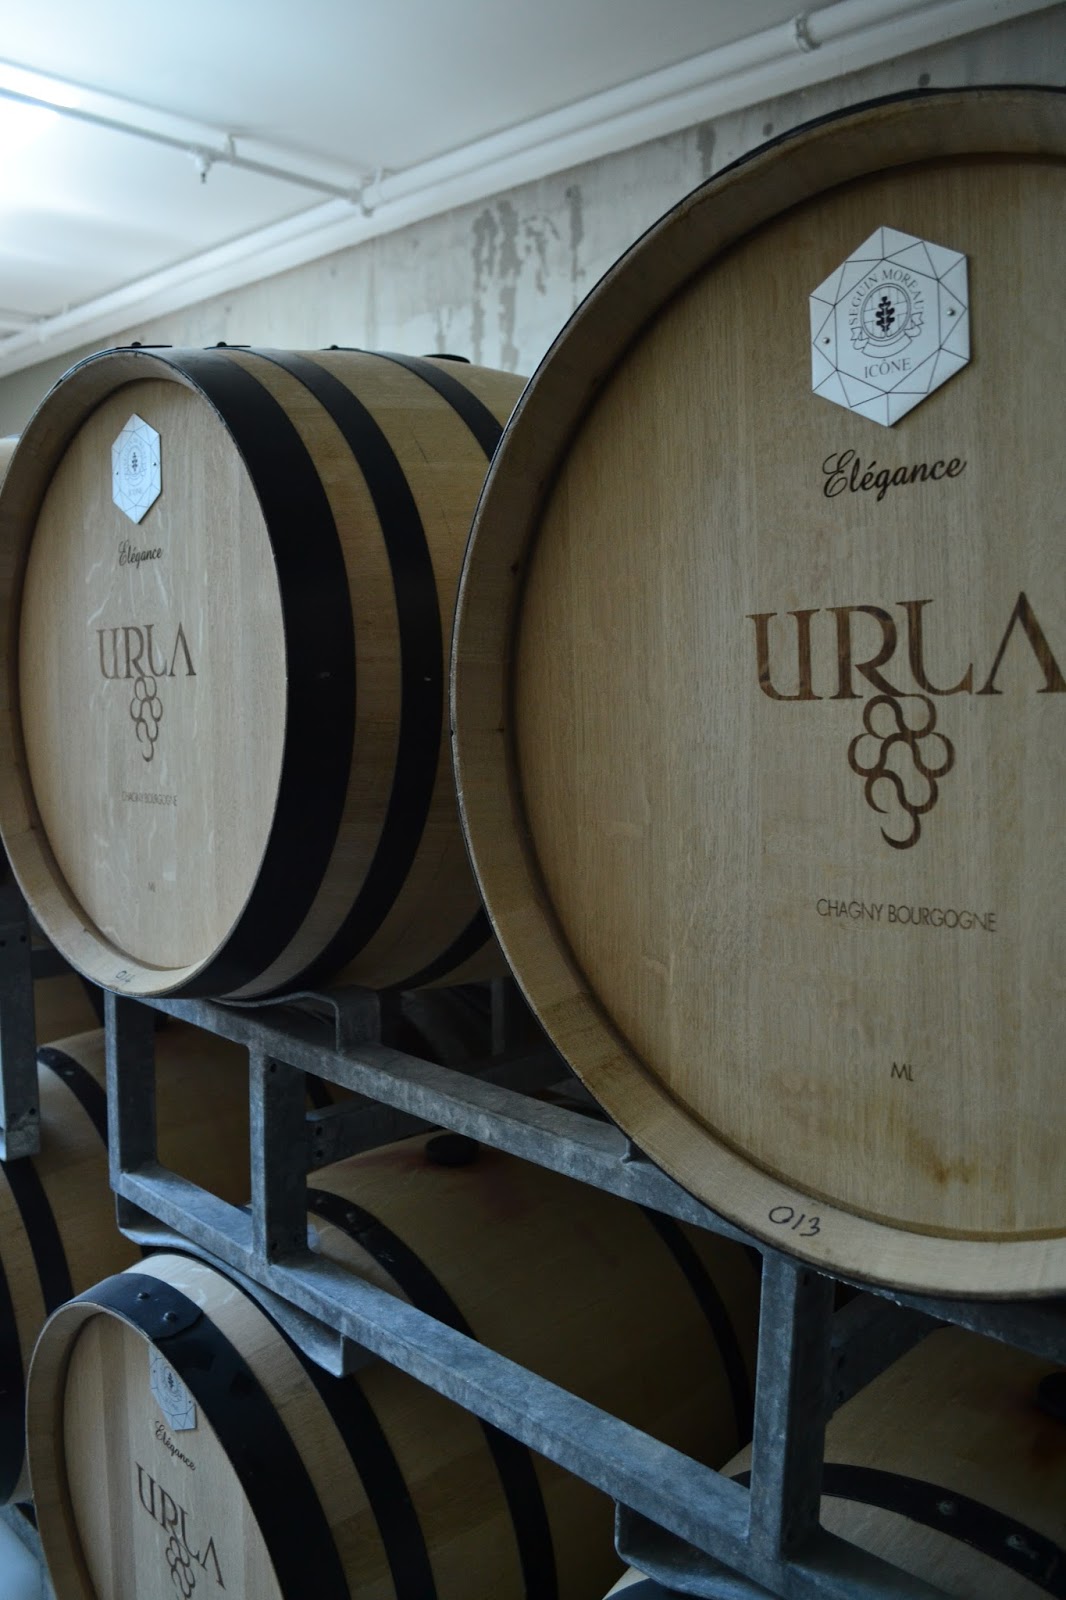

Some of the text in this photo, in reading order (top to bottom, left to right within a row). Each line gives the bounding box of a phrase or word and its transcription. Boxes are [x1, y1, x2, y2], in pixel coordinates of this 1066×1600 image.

[848, 268, 924, 326] SEGUIN MOREAU
[863, 358, 912, 379] ICÔNE
[822, 449, 967, 502] Elégance
[96, 620, 197, 680] URLA
[745, 590, 1066, 701] URLA
[816, 898, 998, 933] CHAGNY BOURGOGNE
[890, 1061, 915, 1082] ML
[768, 1206, 821, 1237] 013
[135, 1461, 227, 1591] URLA
